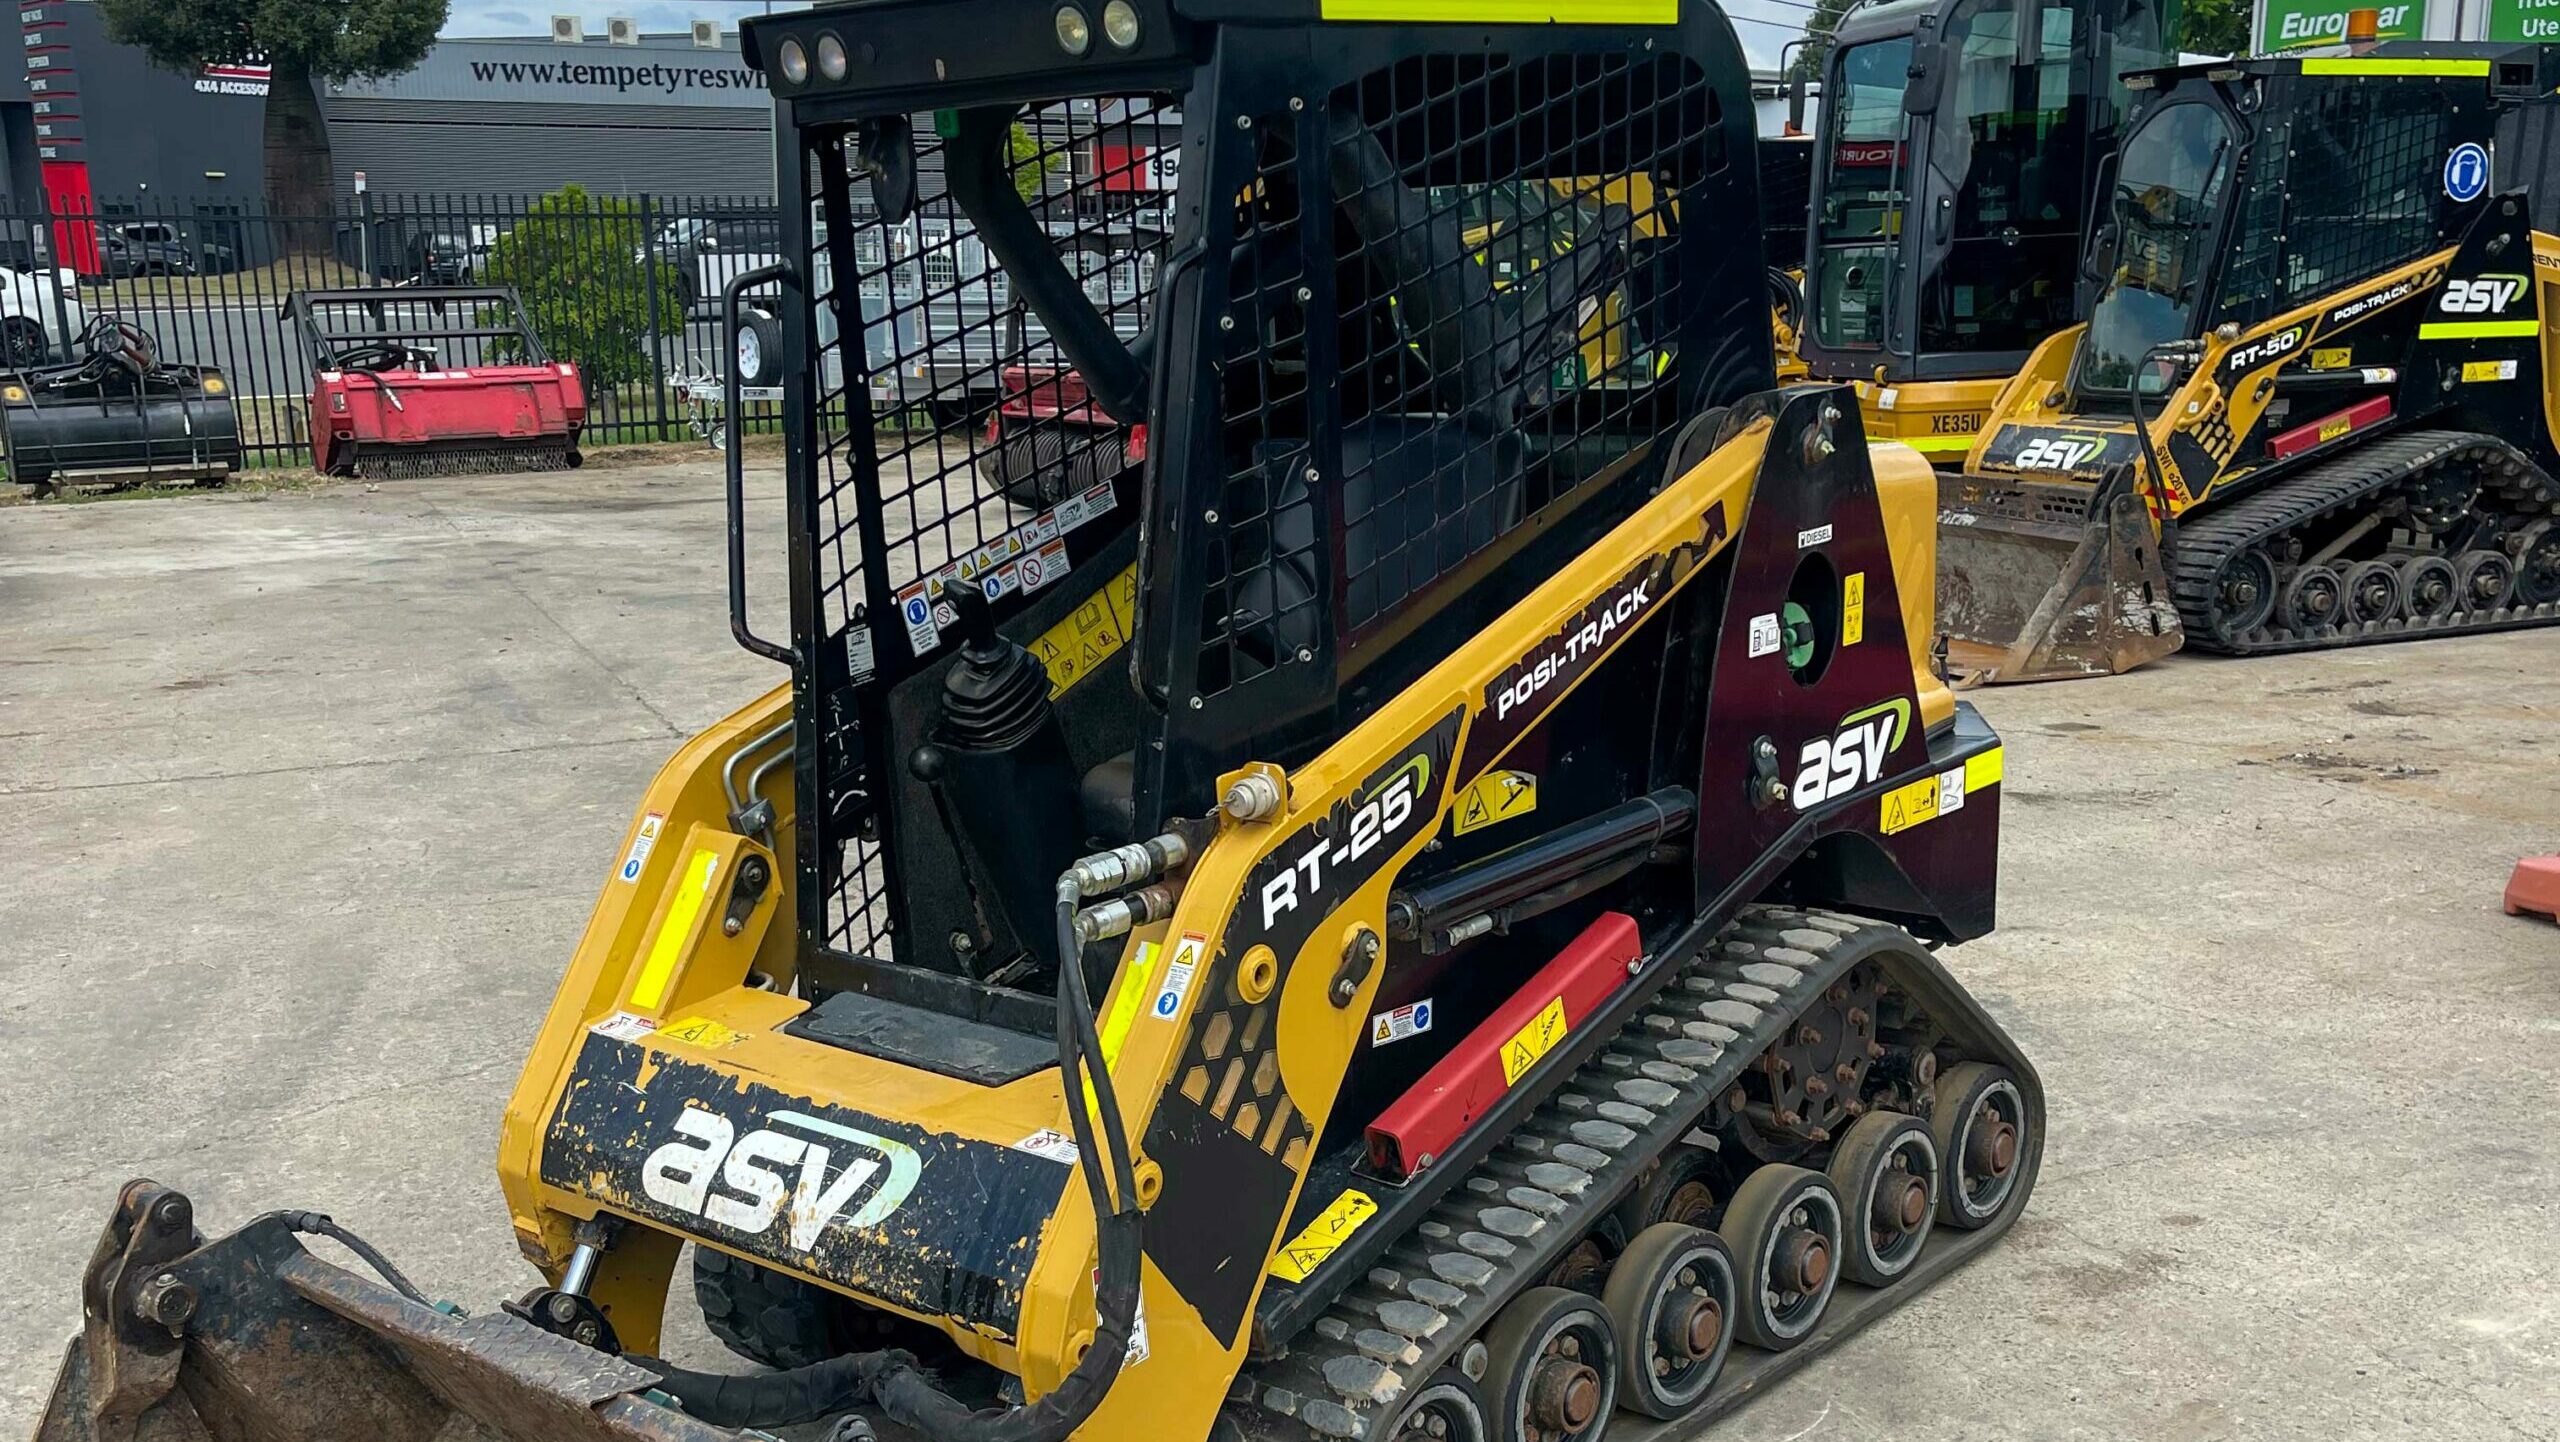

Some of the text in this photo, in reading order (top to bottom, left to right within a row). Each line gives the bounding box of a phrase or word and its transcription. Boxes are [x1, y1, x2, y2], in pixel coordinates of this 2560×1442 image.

[2279, 5, 2410, 42] Euroar
[1152, 158, 1180, 177] 99
[2333, 284, 2409, 322] POSI-TRACK
[2230, 333, 2295, 370] RT-50
[1932, 414, 1981, 433] XE35U
[1805, 528, 1831, 544] DIESEL
[1498, 578, 1649, 721] POSI-TRACK
[1262, 774, 1413, 931] RT-25
